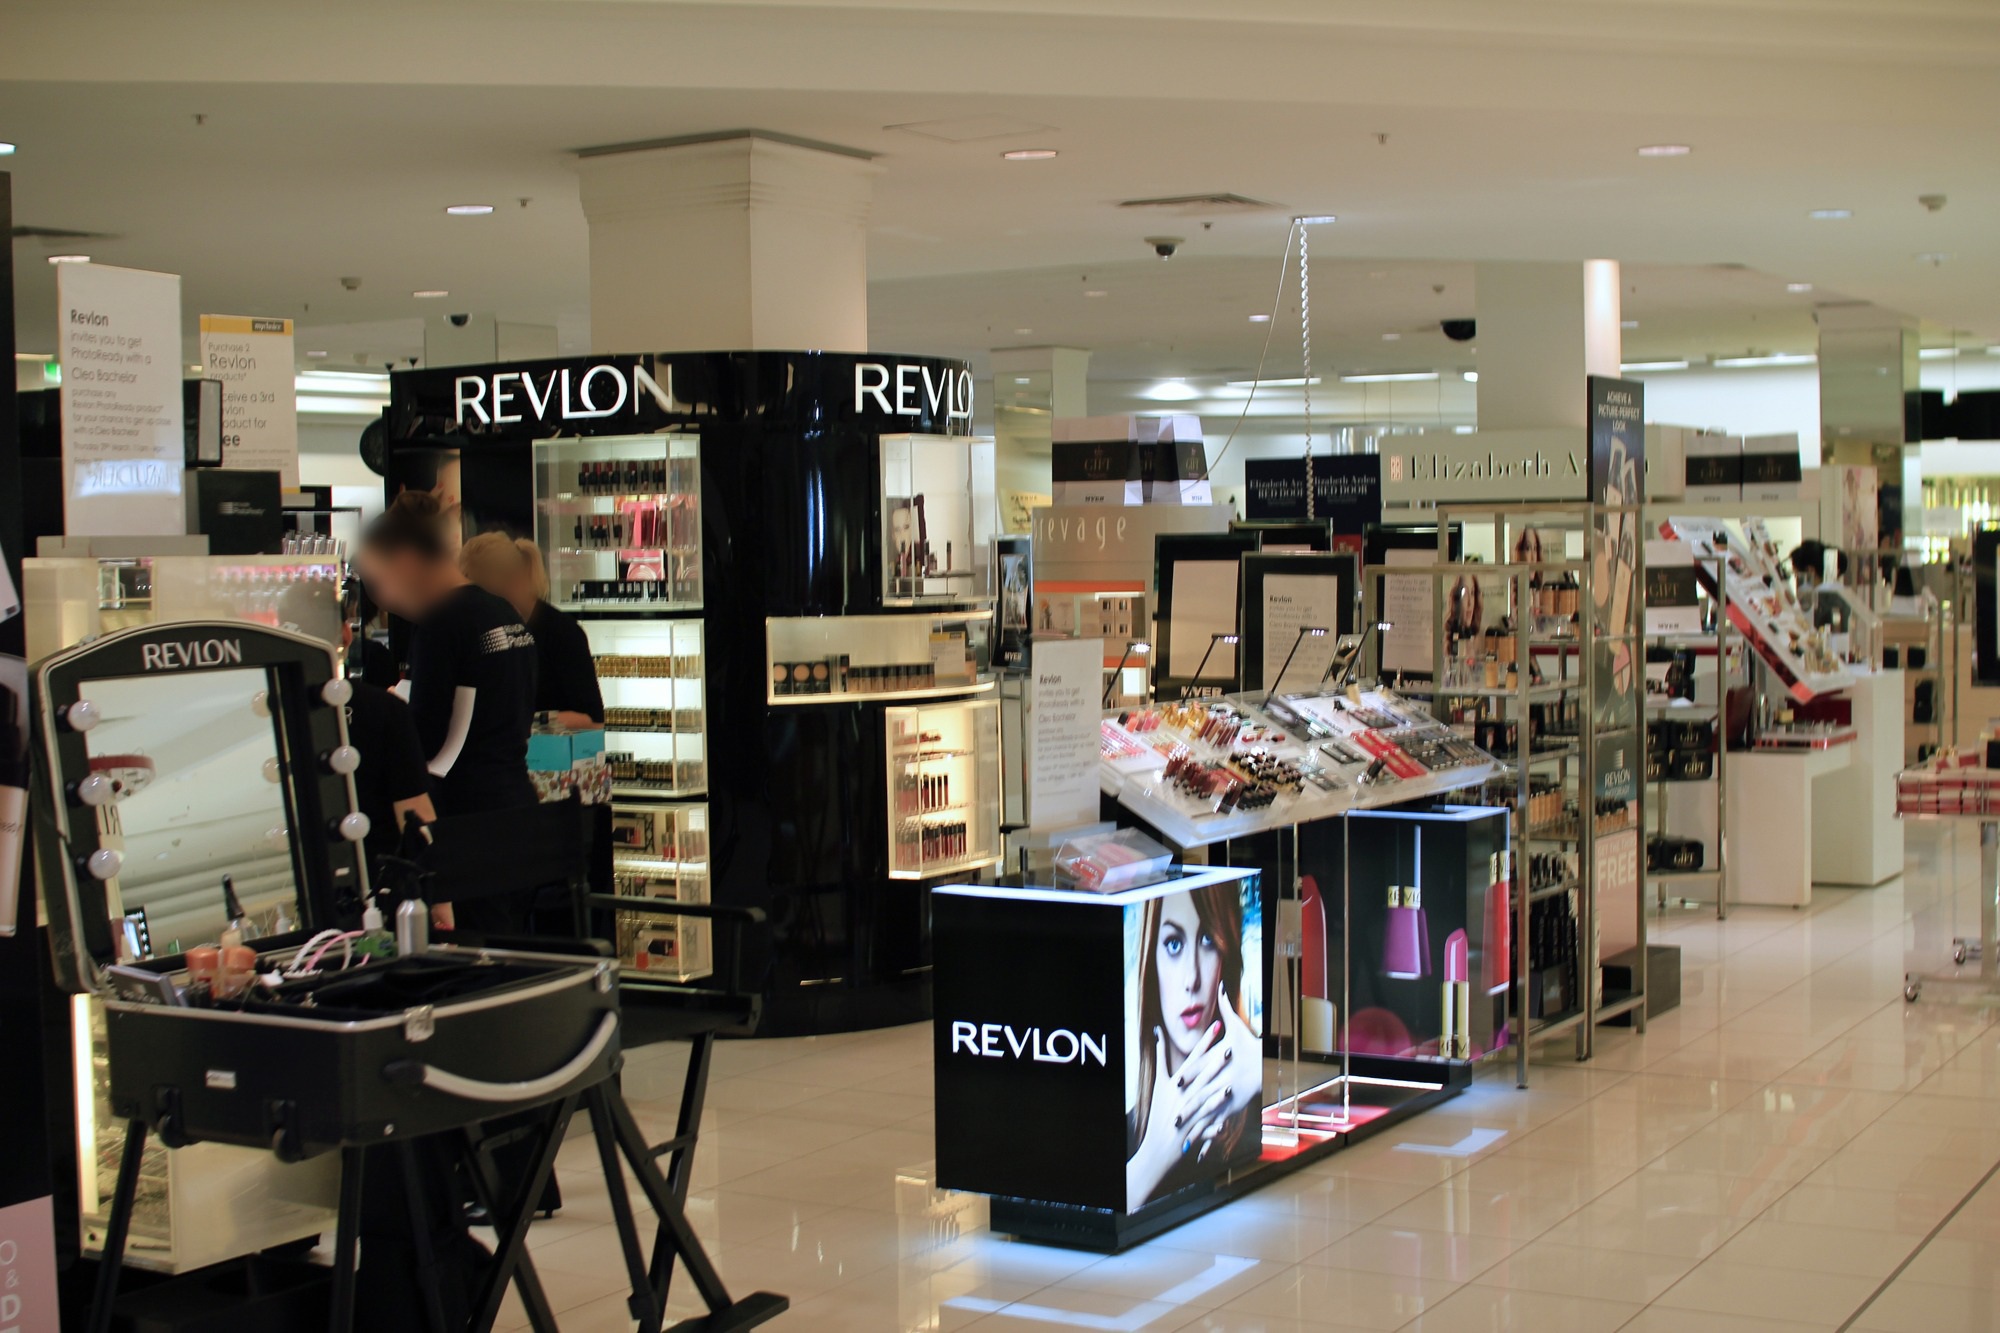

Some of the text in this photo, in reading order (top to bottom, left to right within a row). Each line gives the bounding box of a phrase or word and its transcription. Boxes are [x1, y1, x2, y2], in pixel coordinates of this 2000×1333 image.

[71, 309, 109, 327] Revlon
[71, 330, 142, 349] invites you to get
[208, 342, 250, 352] Purchase 2
[126, 353, 144, 363] with
[145, 355, 152, 365] a
[209, 353, 256, 370] Revlon
[71, 367, 138, 384] Cleo Bachelor
[223, 391, 275, 403] ceive a 3rd
[455, 363, 673, 426] REVLON
[855, 363, 973, 418] REVLO
[1607, 391, 1627, 405] ACHIEVE
[223, 417, 267, 429] oduct for
[1613, 420, 1627, 432] LOOK
[223, 434, 241, 447] ee
[1412, 449, 1551, 481] Elizabeth
[1314, 475, 1348, 486] lizabeth
[1351, 474, 1376, 485] Arden
[1269, 594, 1293, 604] Revlon
[142, 638, 242, 670] REVLON
[1004, 651, 1023, 662] MYER
[1040, 674, 1062, 685] Revlon
[1180, 686, 1224, 698] MYER
[1604, 767, 1631, 788] REVLON
[1674, 852, 1695, 866] GIFT
[1597, 849, 1636, 893] FREE
[952, 1020, 1107, 1067] REVLON
